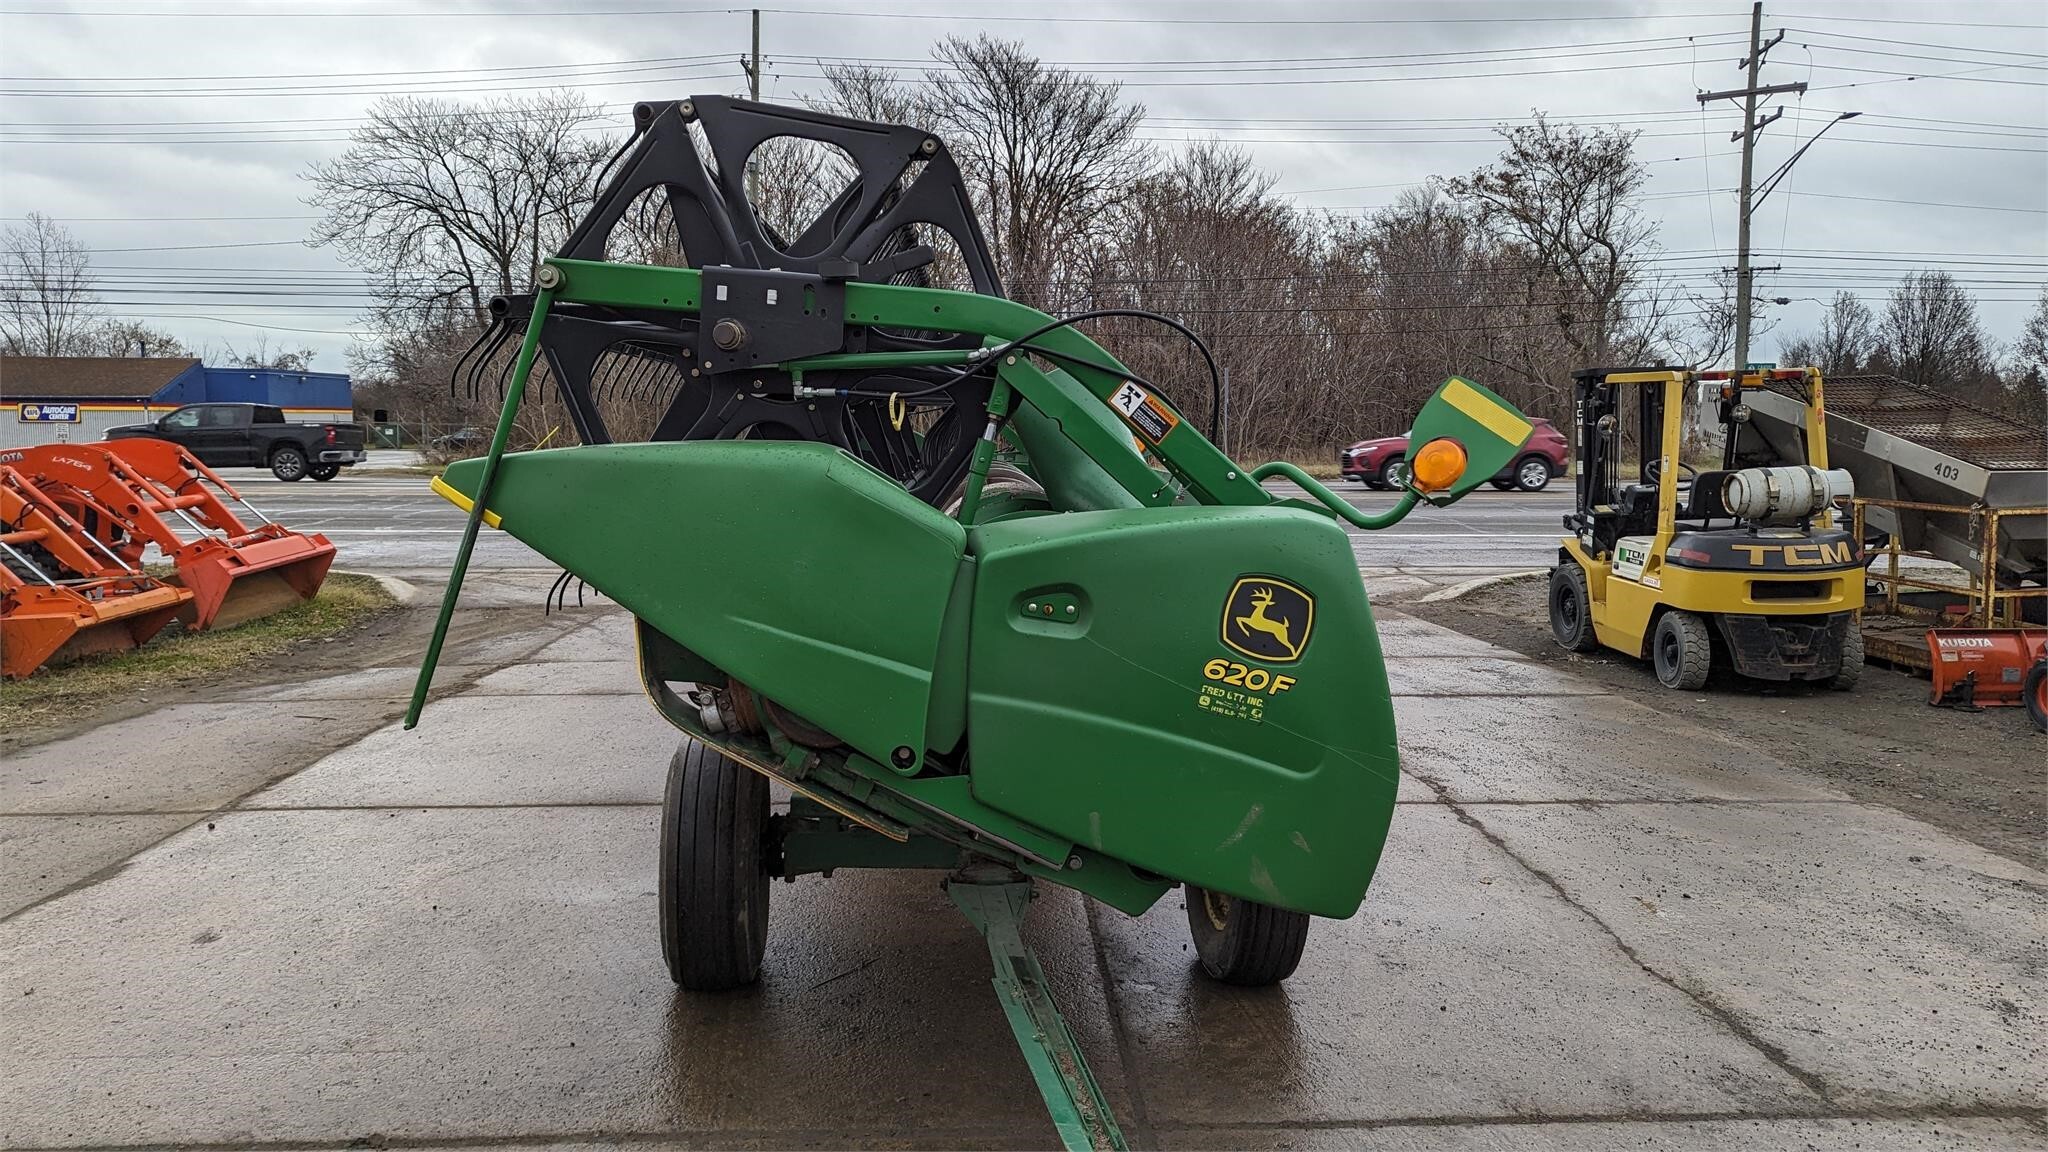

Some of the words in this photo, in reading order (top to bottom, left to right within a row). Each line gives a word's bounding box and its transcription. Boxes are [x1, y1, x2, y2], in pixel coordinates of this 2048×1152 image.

[1151, 402, 1175, 423] WARNING
[1576, 400, 1584, 425] TCM
[1934, 462, 1959, 481] 403
[1626, 548, 1645, 560] TCM
[1731, 541, 1852, 566] TCM
[1937, 638, 1993, 648] KUBOTA
[1203, 658, 1297, 695] 620F
[1201, 684, 1225, 698] FRED
[1247, 696, 1264, 708] INC.
